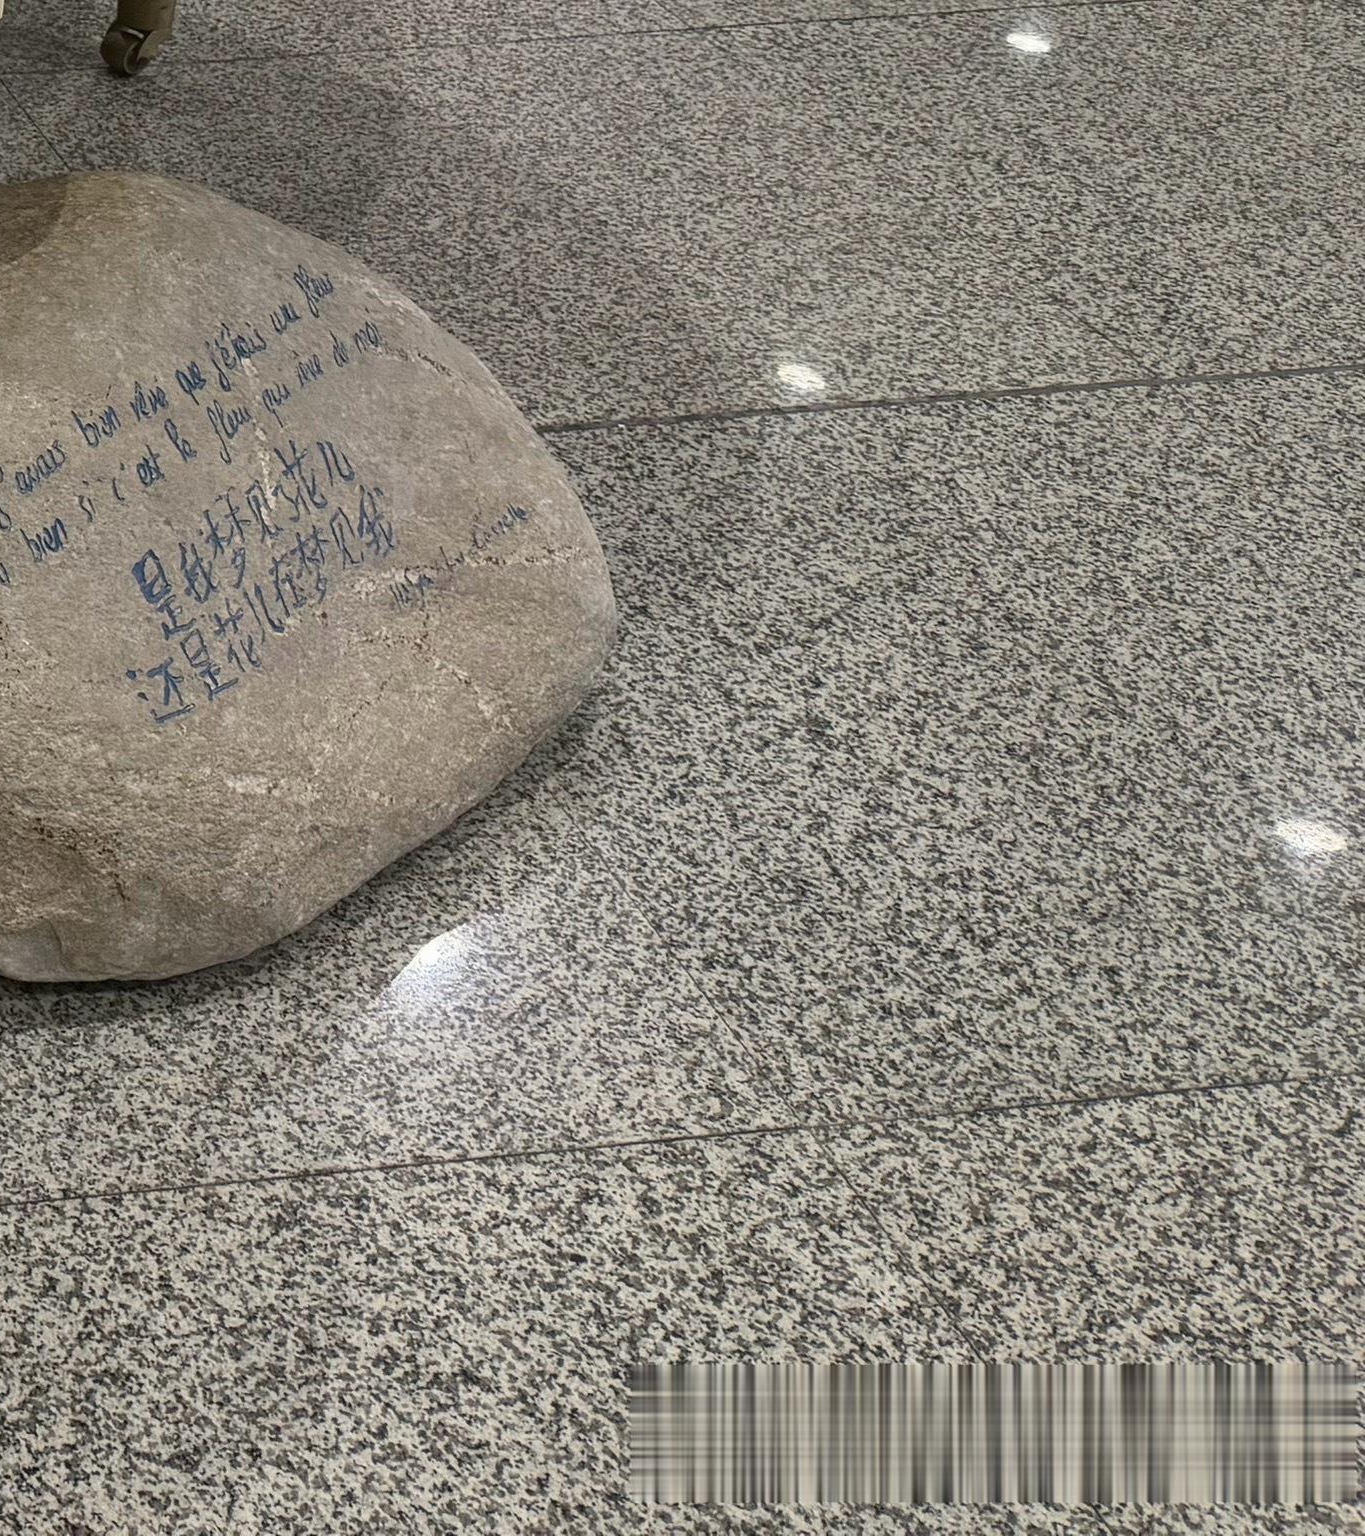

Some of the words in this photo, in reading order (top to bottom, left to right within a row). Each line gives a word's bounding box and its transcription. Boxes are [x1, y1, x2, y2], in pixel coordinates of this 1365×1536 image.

[72, 405, 121, 448] bien
[20, 518, 68, 563] bien
[131, 440, 355, 641] 是我梦见了花儿
[125, 484, 397, 723] 还是花儿在梦见我
